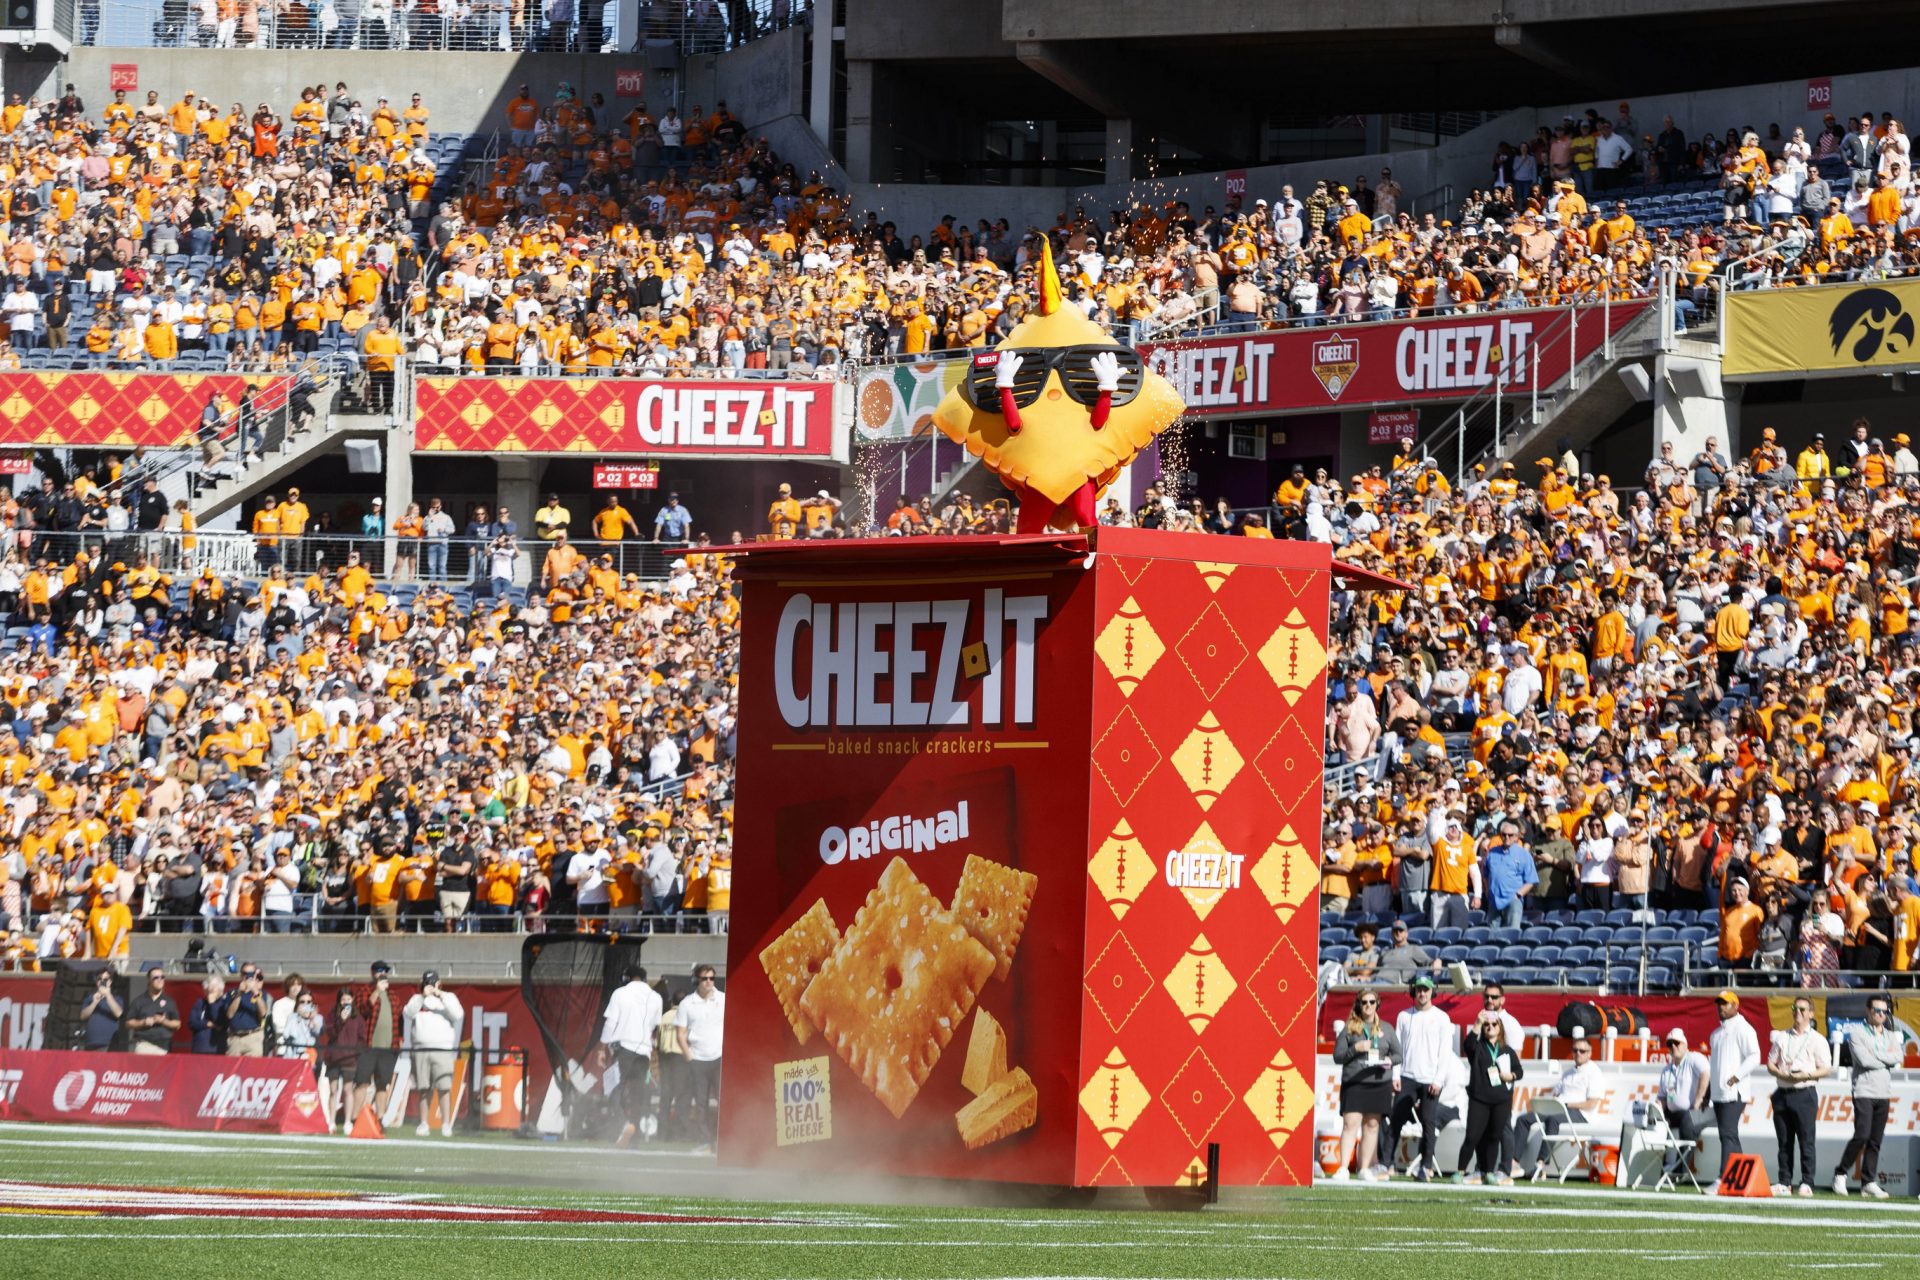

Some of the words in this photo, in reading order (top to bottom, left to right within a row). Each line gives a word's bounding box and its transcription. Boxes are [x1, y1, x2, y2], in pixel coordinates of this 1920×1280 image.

[112, 71, 137, 86] P52
[1808, 86, 1831, 103] P03
[1226, 178, 1245, 194] P02
[828, 737, 871, 755] baked
[878, 737, 919, 755] snack
[926, 736, 991, 754] crackers
[101, 1070, 149, 1087] ORLANDO
[784, 1066, 804, 1080] made
[95, 1086, 165, 1102] INTERNATIONAL
[199, 1073, 288, 1113] MASSEY
[783, 1080, 826, 1105] 100%
[91, 1101, 132, 1116] AIRPORT
[784, 1102, 823, 1125] REAL
[785, 1121, 824, 1140] CHEESE
[1723, 1159, 1755, 1191] 40
